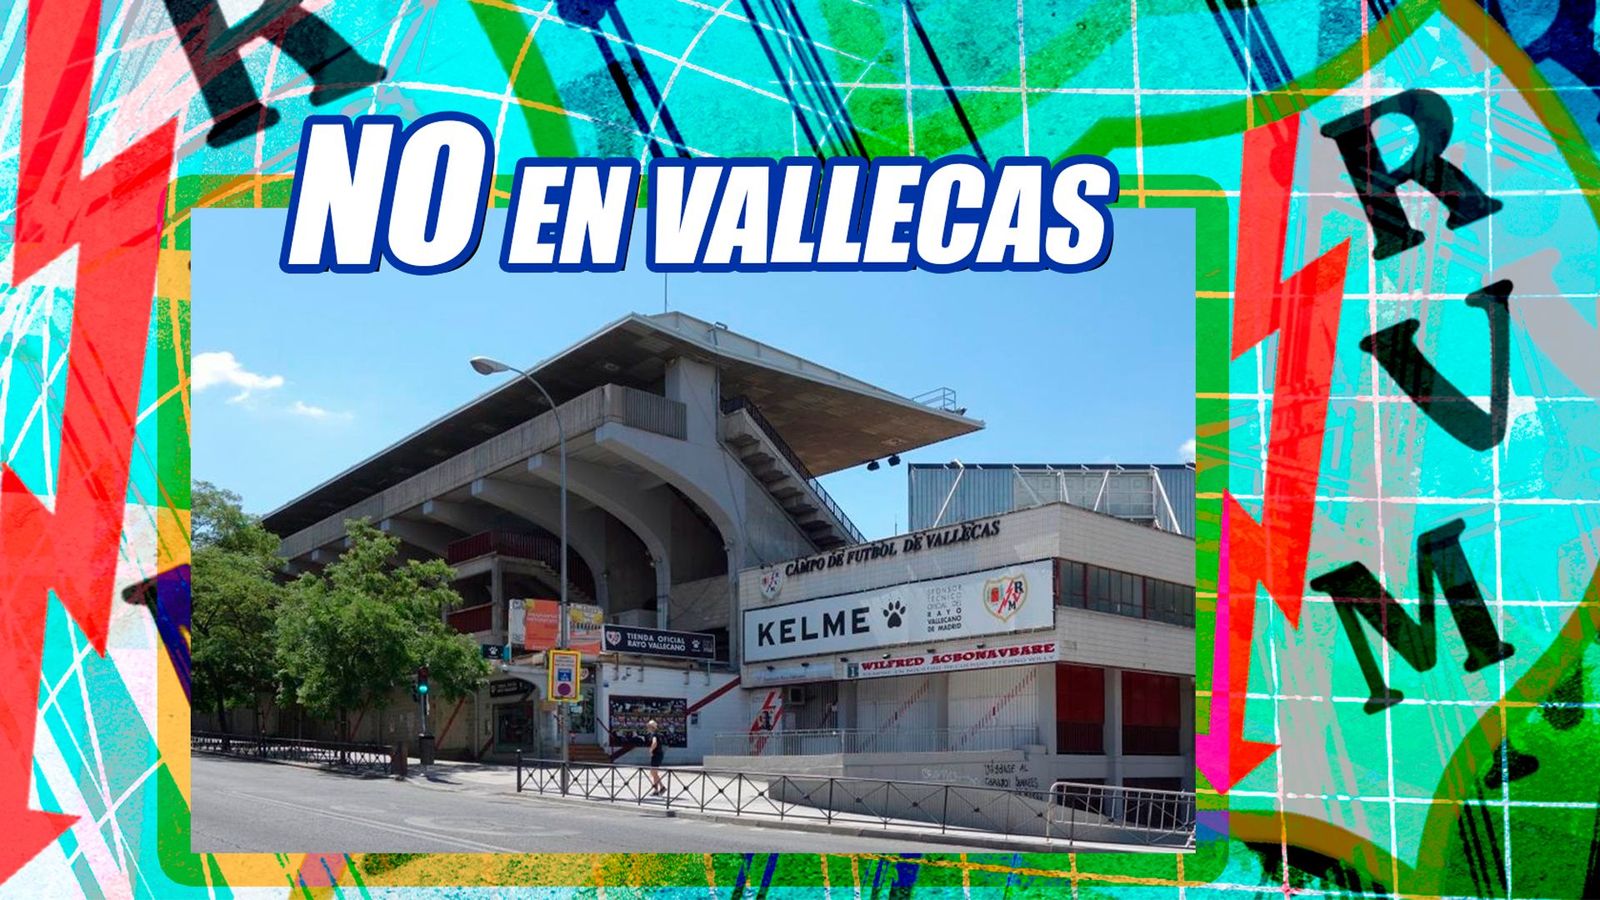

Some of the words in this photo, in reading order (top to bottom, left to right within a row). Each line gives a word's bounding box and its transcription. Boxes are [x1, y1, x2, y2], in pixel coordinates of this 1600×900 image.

[785, 557, 825, 577] CAMPO
[827, 552, 843, 567] DE
[902, 535, 923, 553] DE
[926, 521, 1001, 548] VALLECAS
[927, 584, 962, 595] SPONSOR
[758, 606, 870, 646] KELME
[927, 615, 962, 625] VALLECANO
[938, 623, 962, 631] MADRID
[627, 632, 654, 641] TIENDA
[657, 635, 685, 644] OFICIAL
[627, 640, 646, 648] RAYO
[648, 642, 686, 652] VALLECANO
[861, 657, 925, 671] WILFRED
